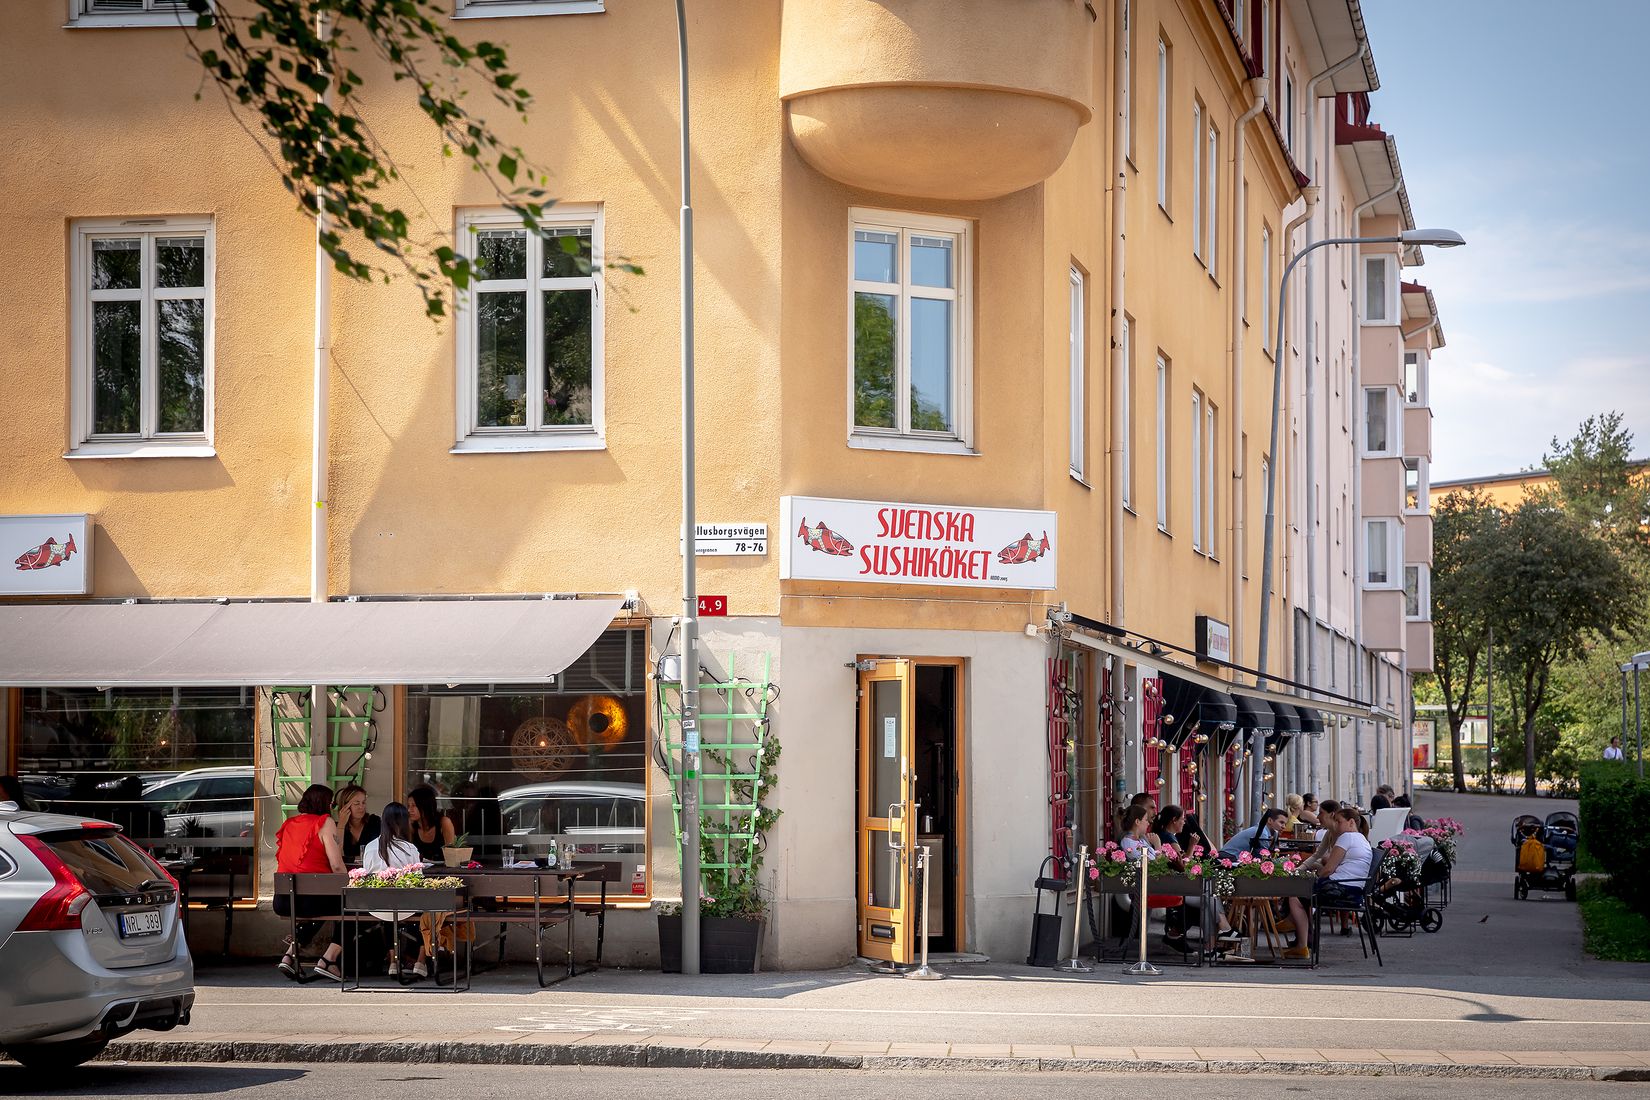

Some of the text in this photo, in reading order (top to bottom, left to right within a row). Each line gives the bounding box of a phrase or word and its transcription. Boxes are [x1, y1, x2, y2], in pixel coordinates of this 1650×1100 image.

[695, 526, 765, 538] llusborgsvägen
[876, 508, 975, 543] SVENSKA
[735, 543, 764, 553] 78-76
[858, 545, 993, 581] SUSHIKÖKET
[125, 894, 167, 904] VOLVO
[126, 914, 160, 933] NRL 389
